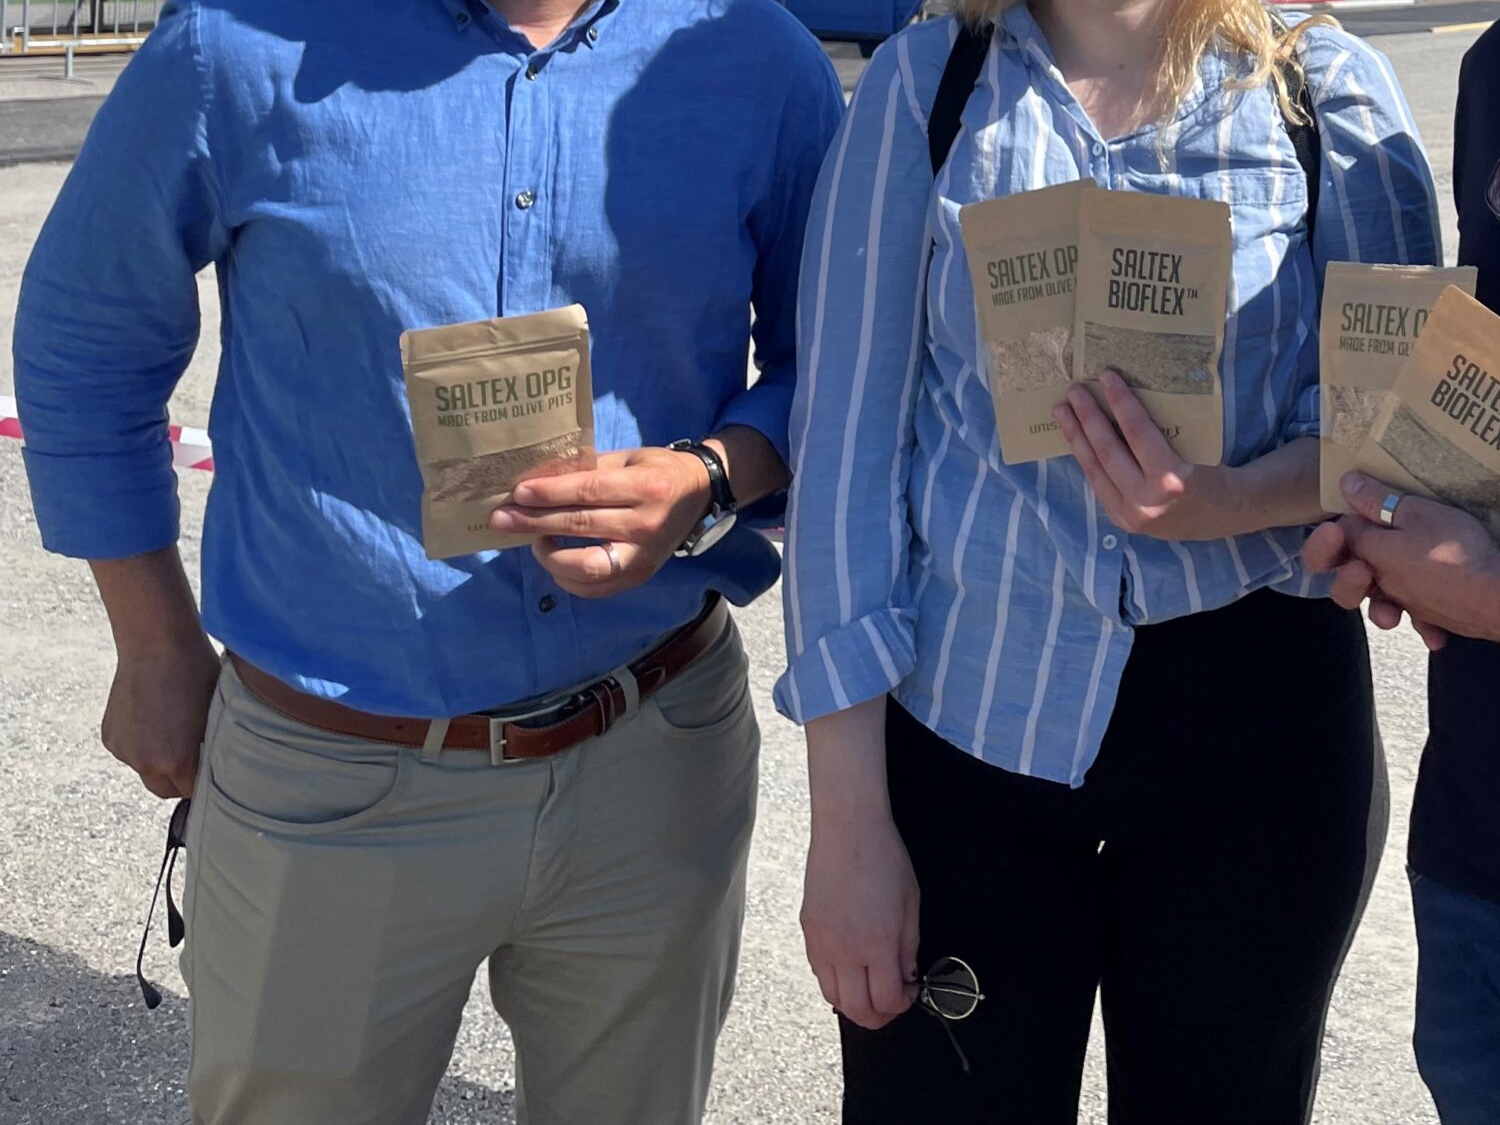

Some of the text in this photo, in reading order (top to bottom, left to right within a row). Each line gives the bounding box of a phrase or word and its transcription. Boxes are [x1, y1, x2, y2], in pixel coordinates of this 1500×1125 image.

[987, 245, 1078, 289] SALTEX OP
[1111, 247, 1182, 284] SALTEX
[992, 278, 1073, 307] MADE FROM OLIVE
[1341, 302, 1409, 337] SALTEX
[1339, 335, 1365, 352] MADE
[1367, 338, 1395, 355] FROM
[435, 366, 571, 412] SALTEX OPG
[437, 391, 573, 428] MADE FROM OLIVE PITS
